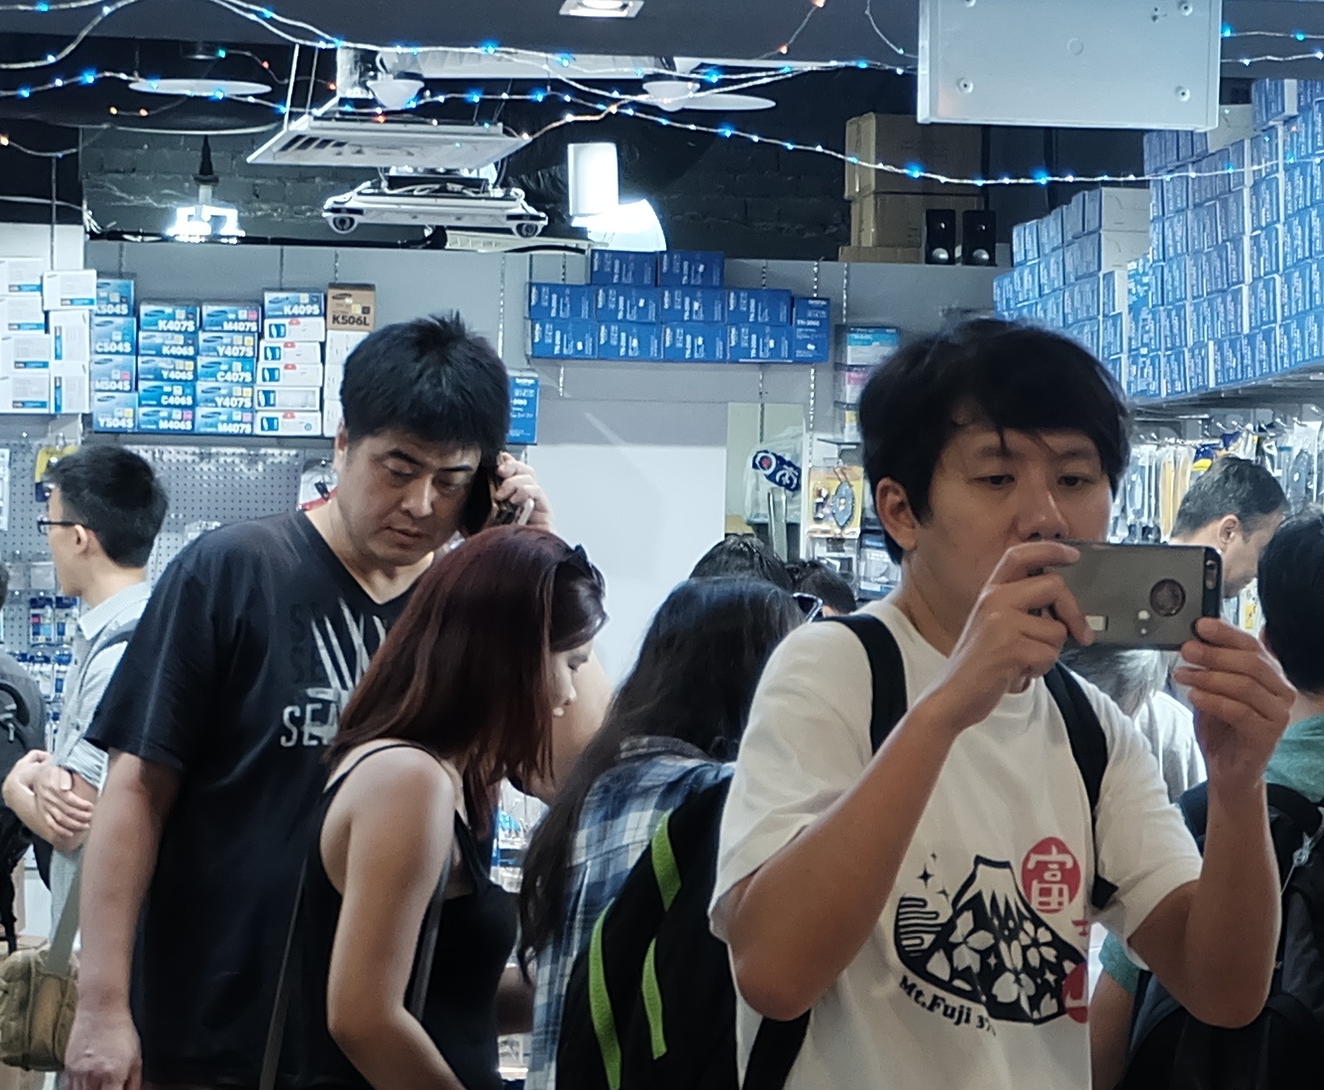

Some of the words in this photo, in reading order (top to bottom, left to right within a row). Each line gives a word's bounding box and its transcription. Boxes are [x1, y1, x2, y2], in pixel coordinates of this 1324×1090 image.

[283, 304, 320, 315] K409S
[332, 314, 370, 326] K506L
[158, 320, 195, 332] K407S
[223, 321, 258, 332] M407S
[217, 346, 254, 357] Y407S
[216, 371, 252, 382] C407S
[214, 397, 252, 408] Y407S
[217, 423, 252, 434] M407S
